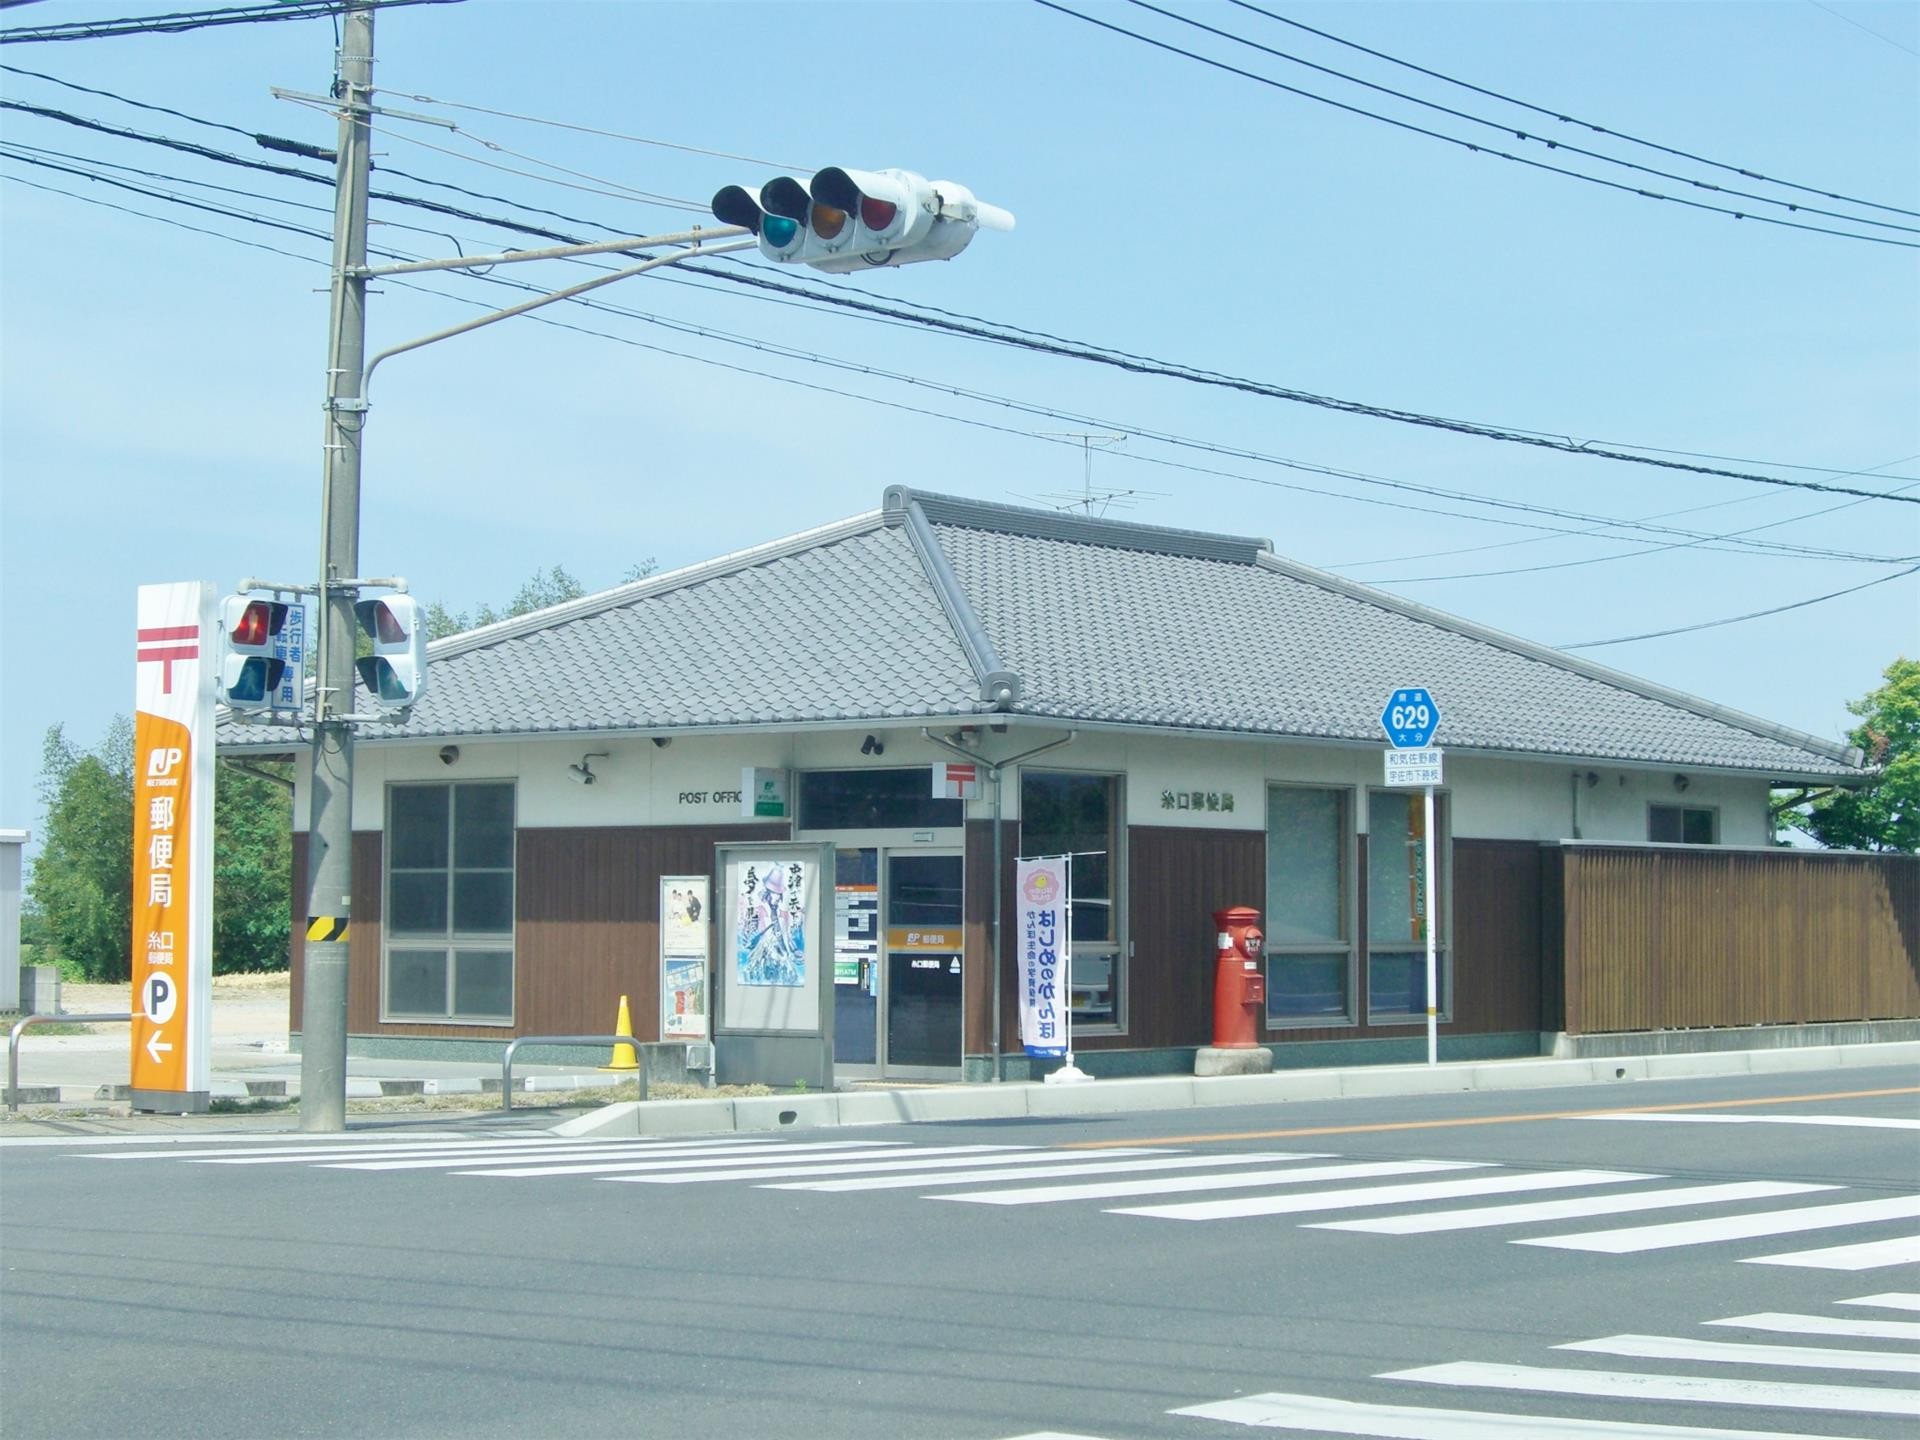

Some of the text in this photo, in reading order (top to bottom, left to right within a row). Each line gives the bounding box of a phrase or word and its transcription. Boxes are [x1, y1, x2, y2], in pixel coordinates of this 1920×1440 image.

[289, 610, 302, 662] 歩行者
[1391, 704, 1430, 730] 629
[1398, 732, 1424, 743] 大分
[147, 748, 182, 776] JP
[1389, 752, 1438, 765] 和気佐野線
[679, 790, 743, 804] POST OFFIC
[1161, 789, 1234, 812] 糸口郵便局
[148, 796, 174, 908] 郵便局
[147, 931, 174, 950] 糸口
[150, 979, 169, 1016] P
